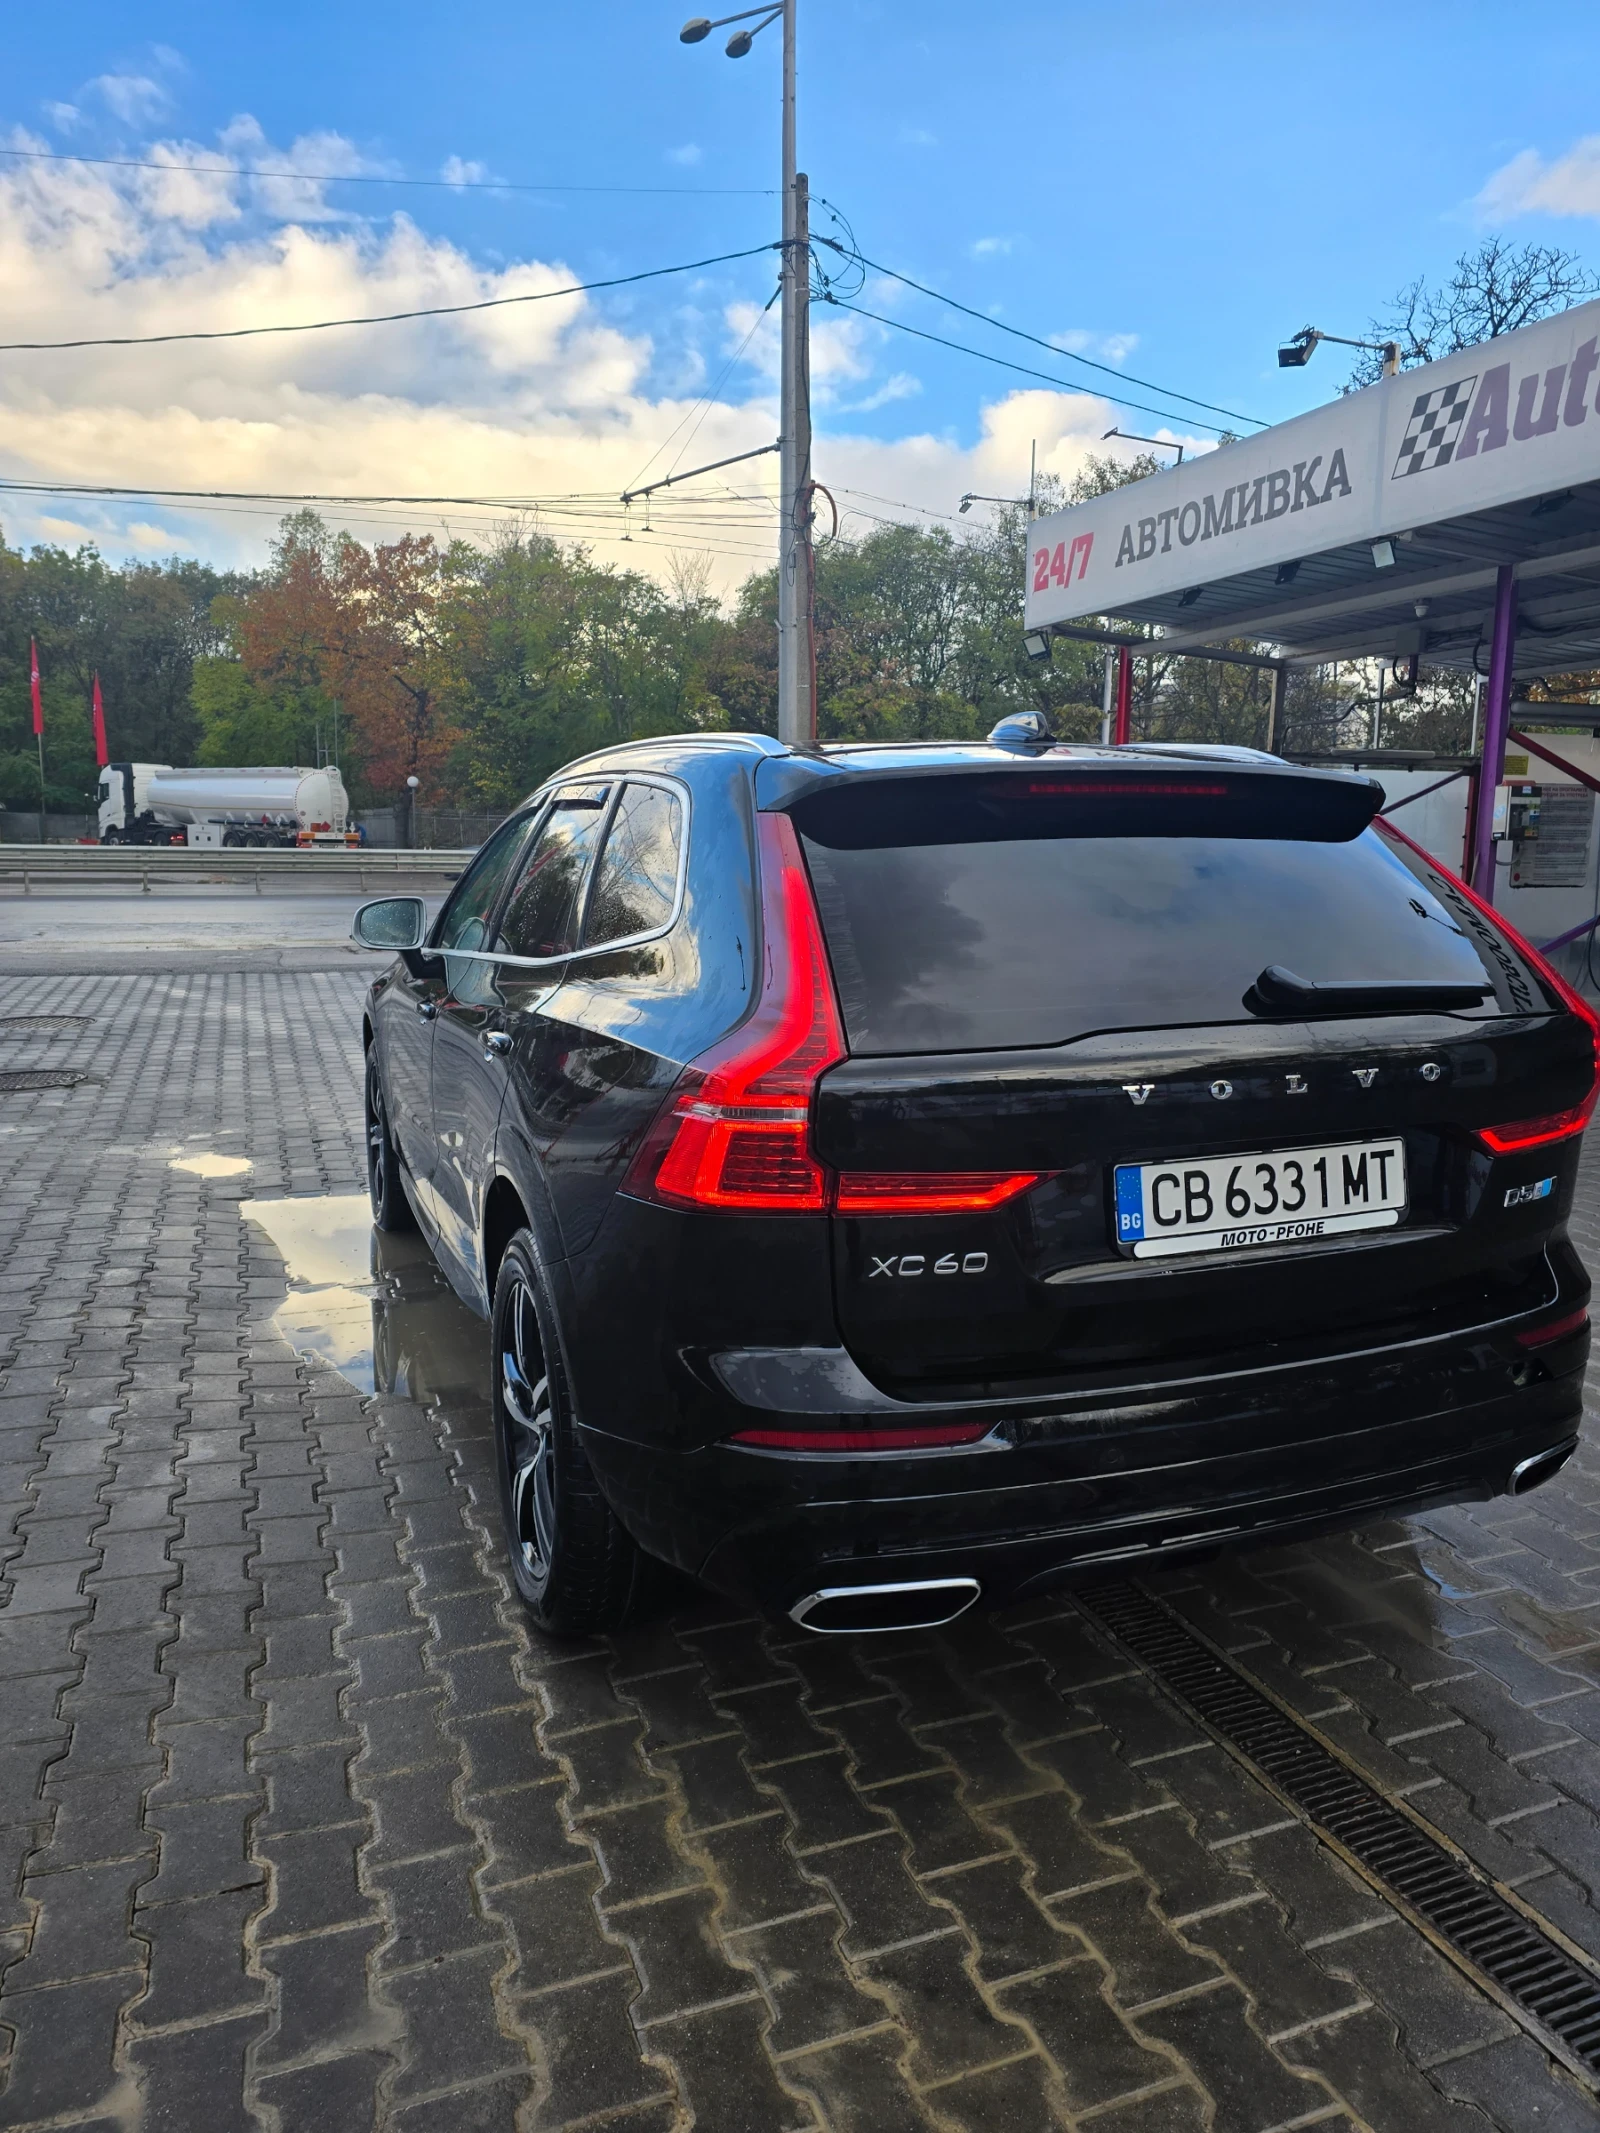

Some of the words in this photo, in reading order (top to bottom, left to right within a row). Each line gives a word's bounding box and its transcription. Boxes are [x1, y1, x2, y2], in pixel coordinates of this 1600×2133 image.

[1455, 335, 1600, 462] Aut
[1033, 531, 1094, 592] 24/7
[1115, 447, 1352, 568] АВТОМИВКА
[1122, 1062, 1441, 1106] VOLVO
[1151, 1169, 1214, 1227] CB
[1225, 1156, 1330, 1219] 6331
[1342, 1149, 1395, 1205] MT
[1120, 1213, 1141, 1230] BG
[1220, 1221, 1325, 1247] MOTO-PFOHE
